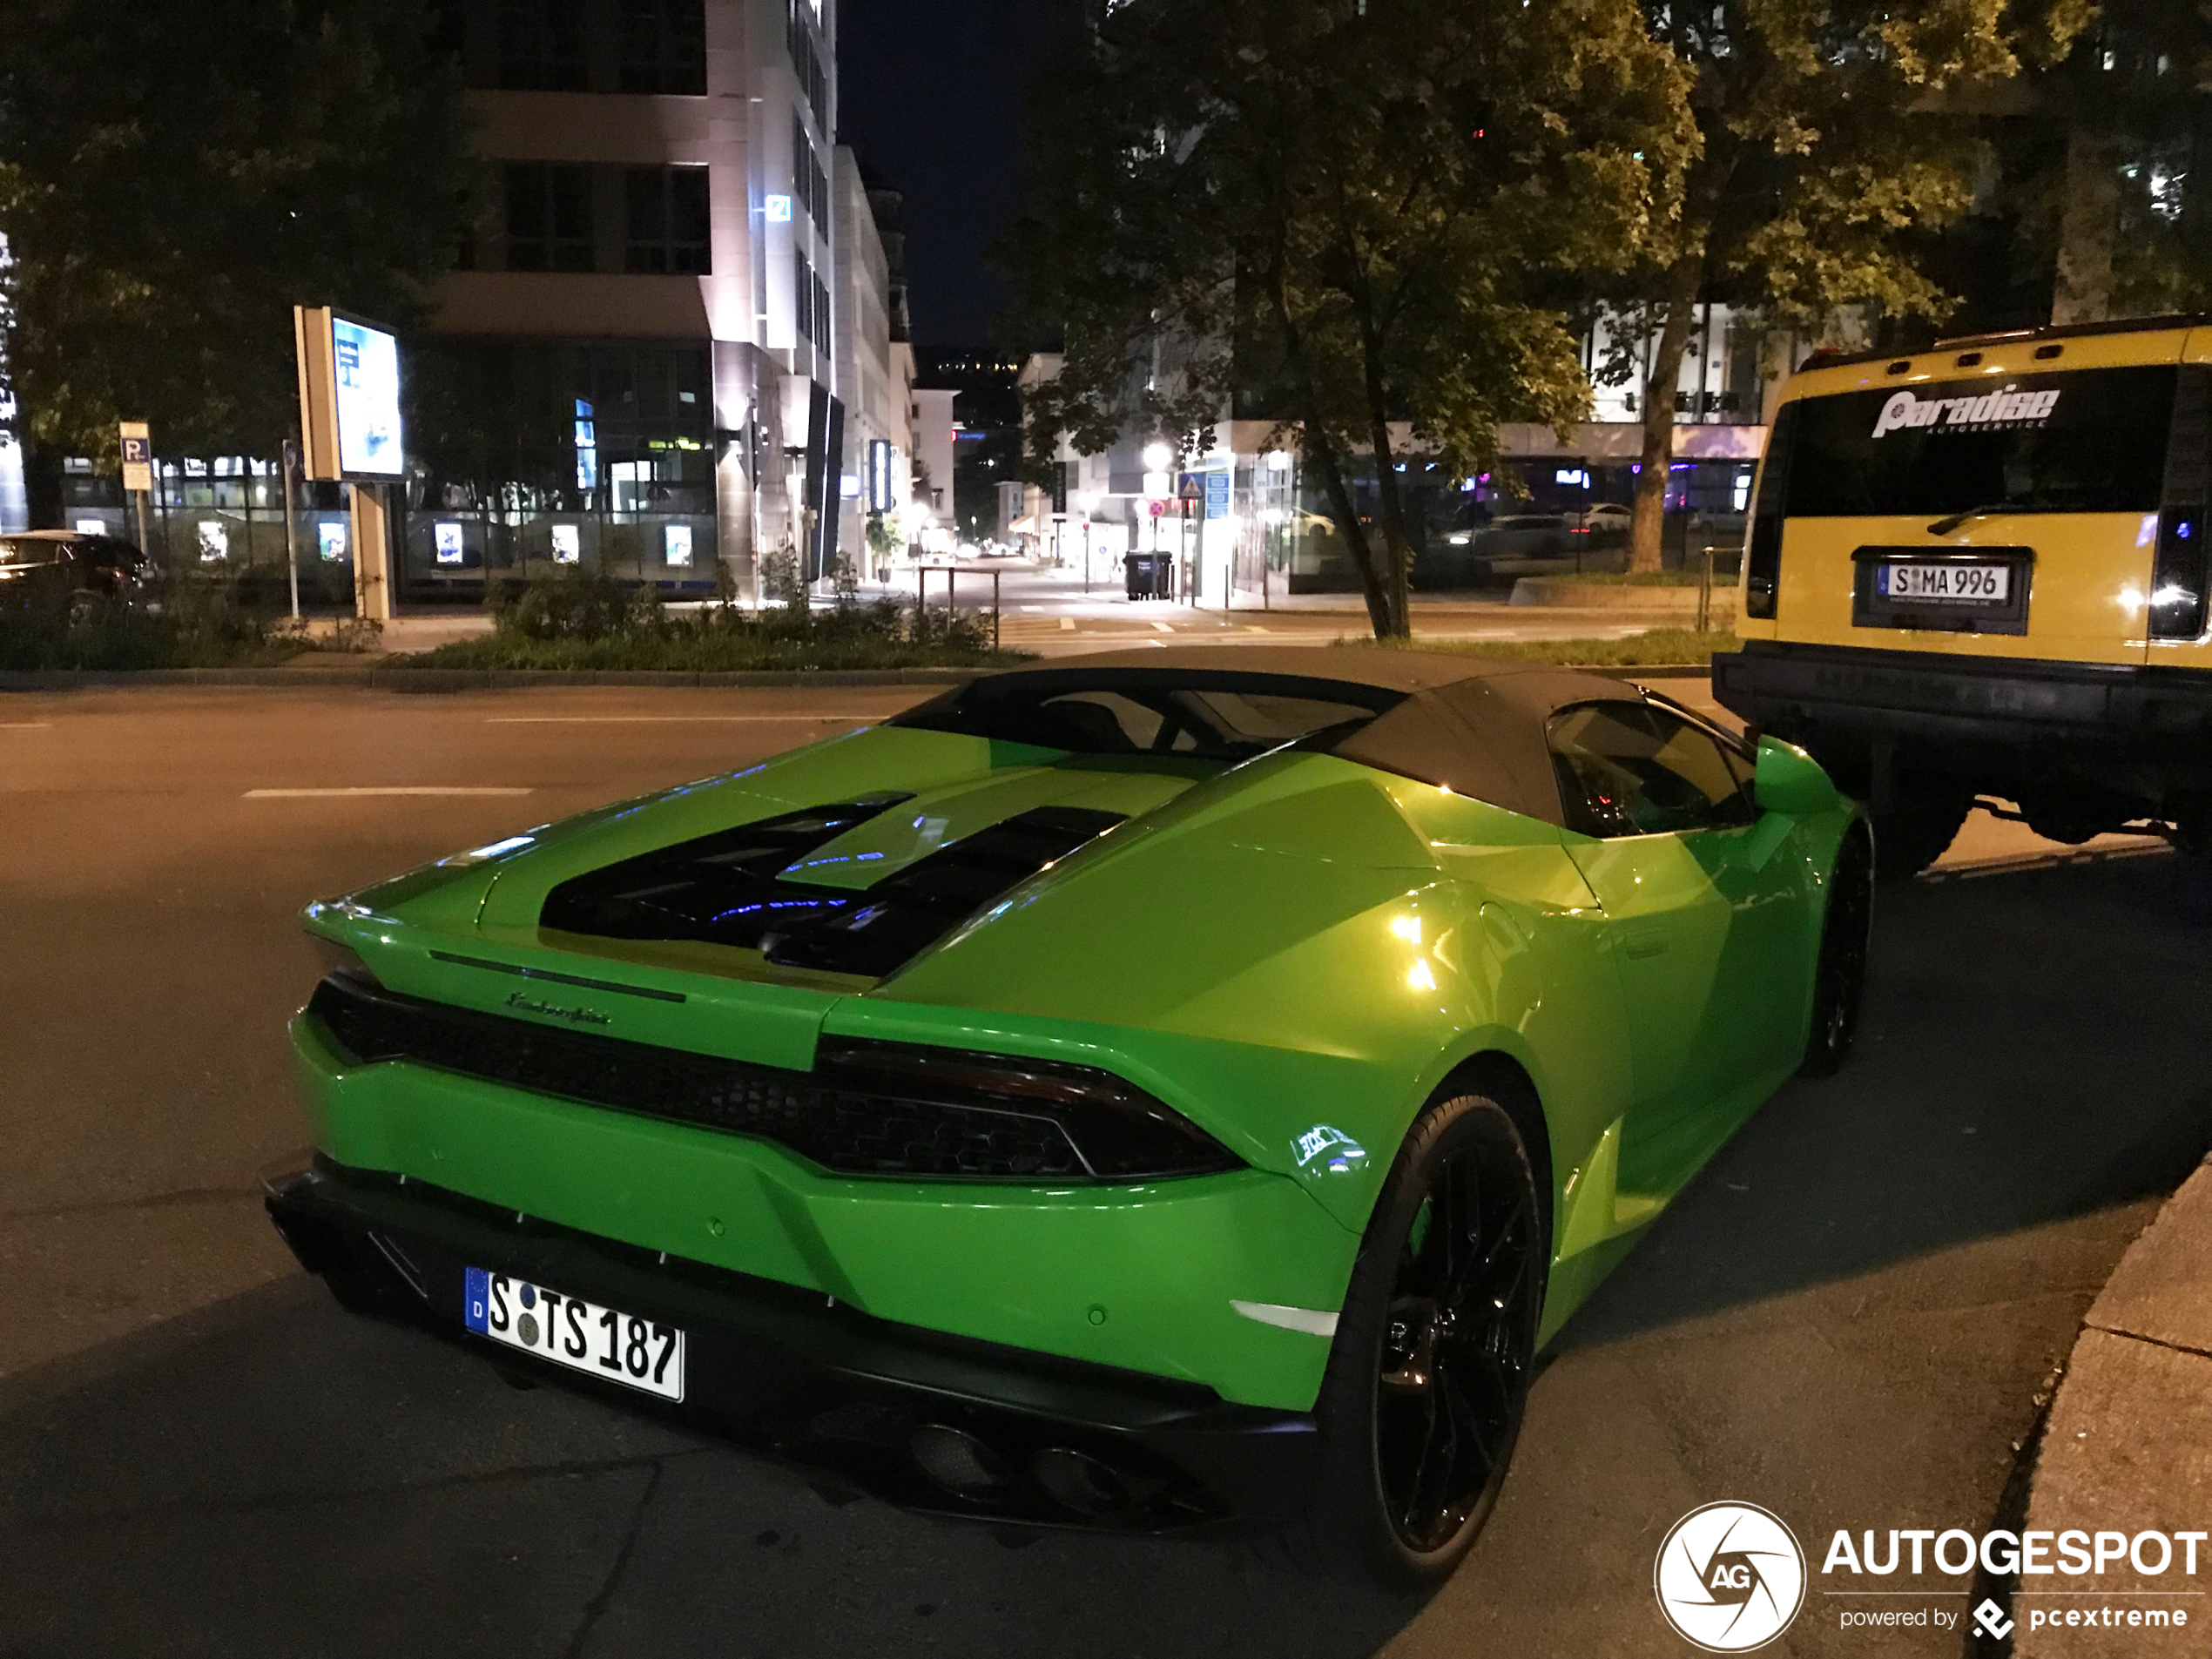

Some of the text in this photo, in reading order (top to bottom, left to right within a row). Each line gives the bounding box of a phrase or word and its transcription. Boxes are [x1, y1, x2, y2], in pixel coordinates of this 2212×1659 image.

[1871, 383, 2060, 439] Paradise
[1925, 420, 2047, 435] AUTOSERVICE
[1895, 568, 1996, 595] S MA 996
[490, 1273, 510, 1332] S
[540, 1289, 588, 1359] TS
[599, 1311, 677, 1385] 187
